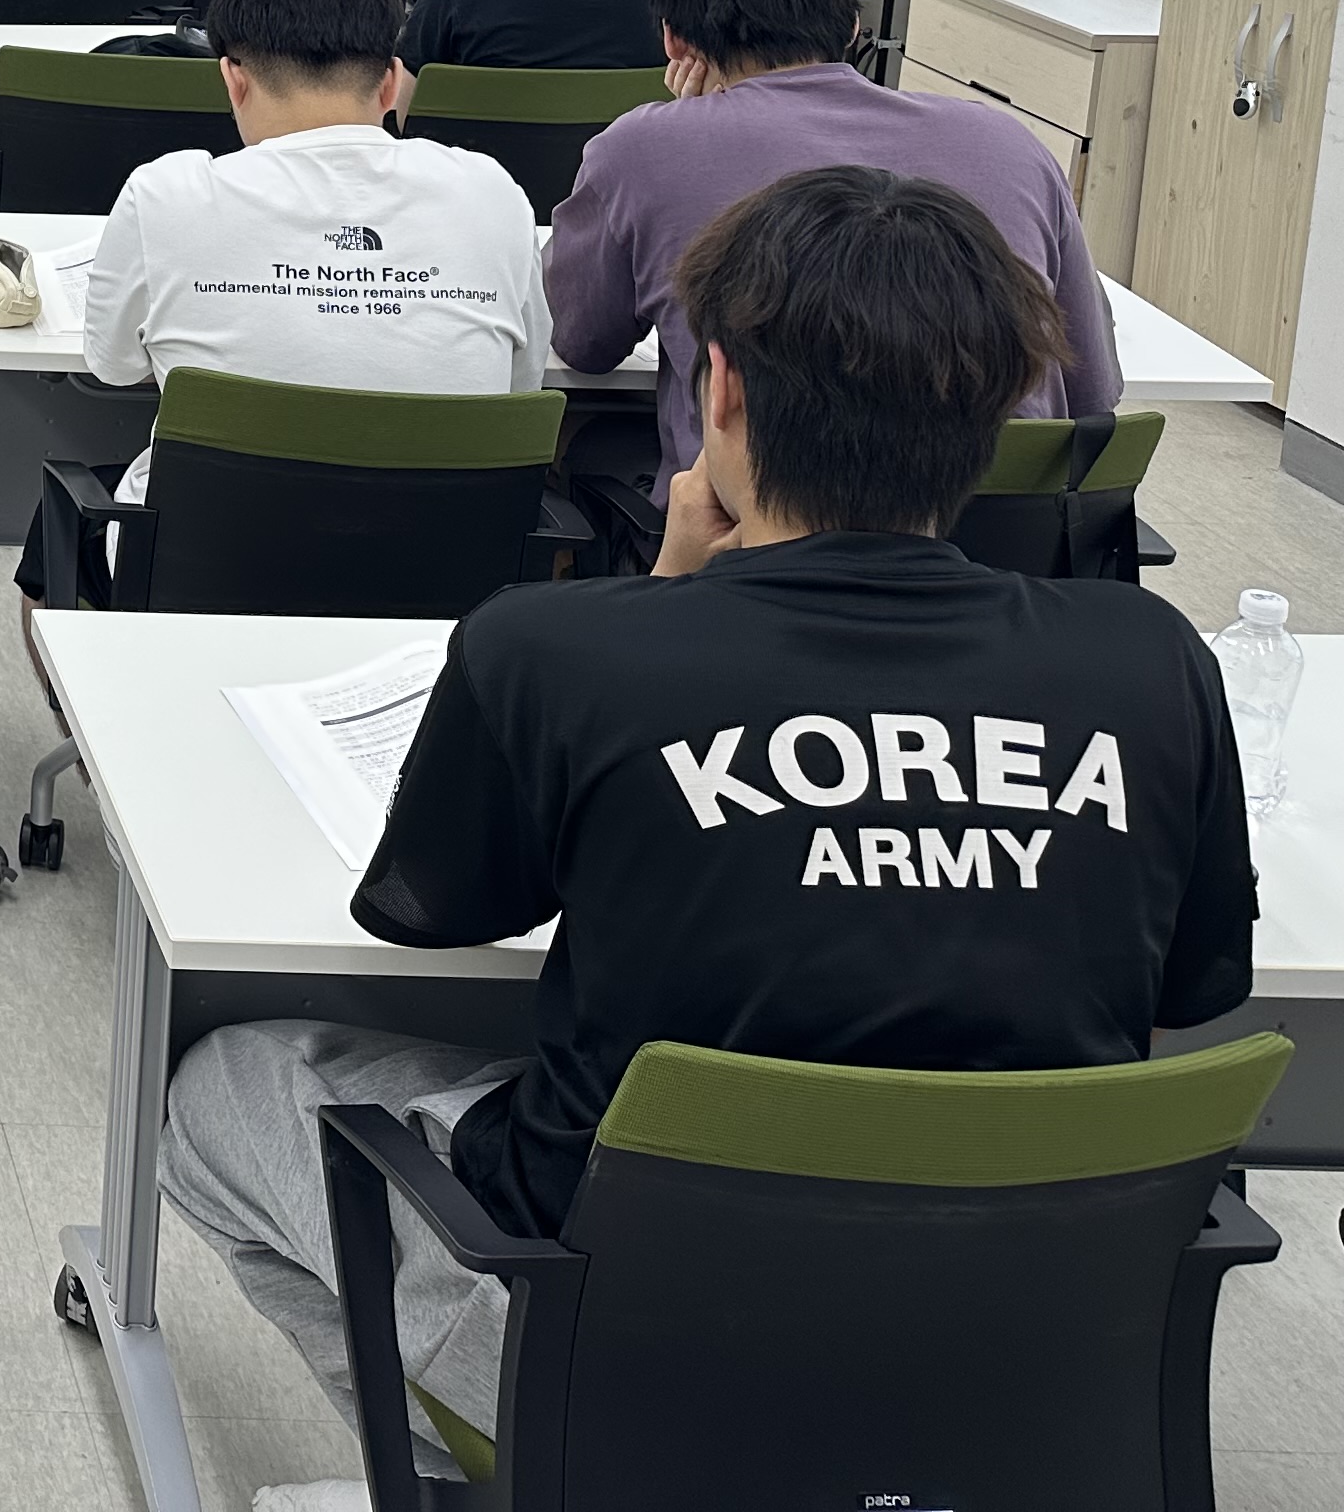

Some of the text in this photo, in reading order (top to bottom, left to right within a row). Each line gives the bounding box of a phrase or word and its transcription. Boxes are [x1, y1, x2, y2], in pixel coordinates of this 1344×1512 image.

[324, 233, 362, 243] NORTH
[341, 226, 362, 235] THE
[335, 242, 363, 251] FACE
[272, 264, 311, 280] The
[318, 265, 375, 282] North
[194, 281, 498, 303] fundamental mission remains unchanged
[317, 301, 402, 316] since 1966
[660, 713, 1128, 833] KOREA
[801, 827, 1052, 888] ARMY
[865, 1493, 911, 1509] patra
